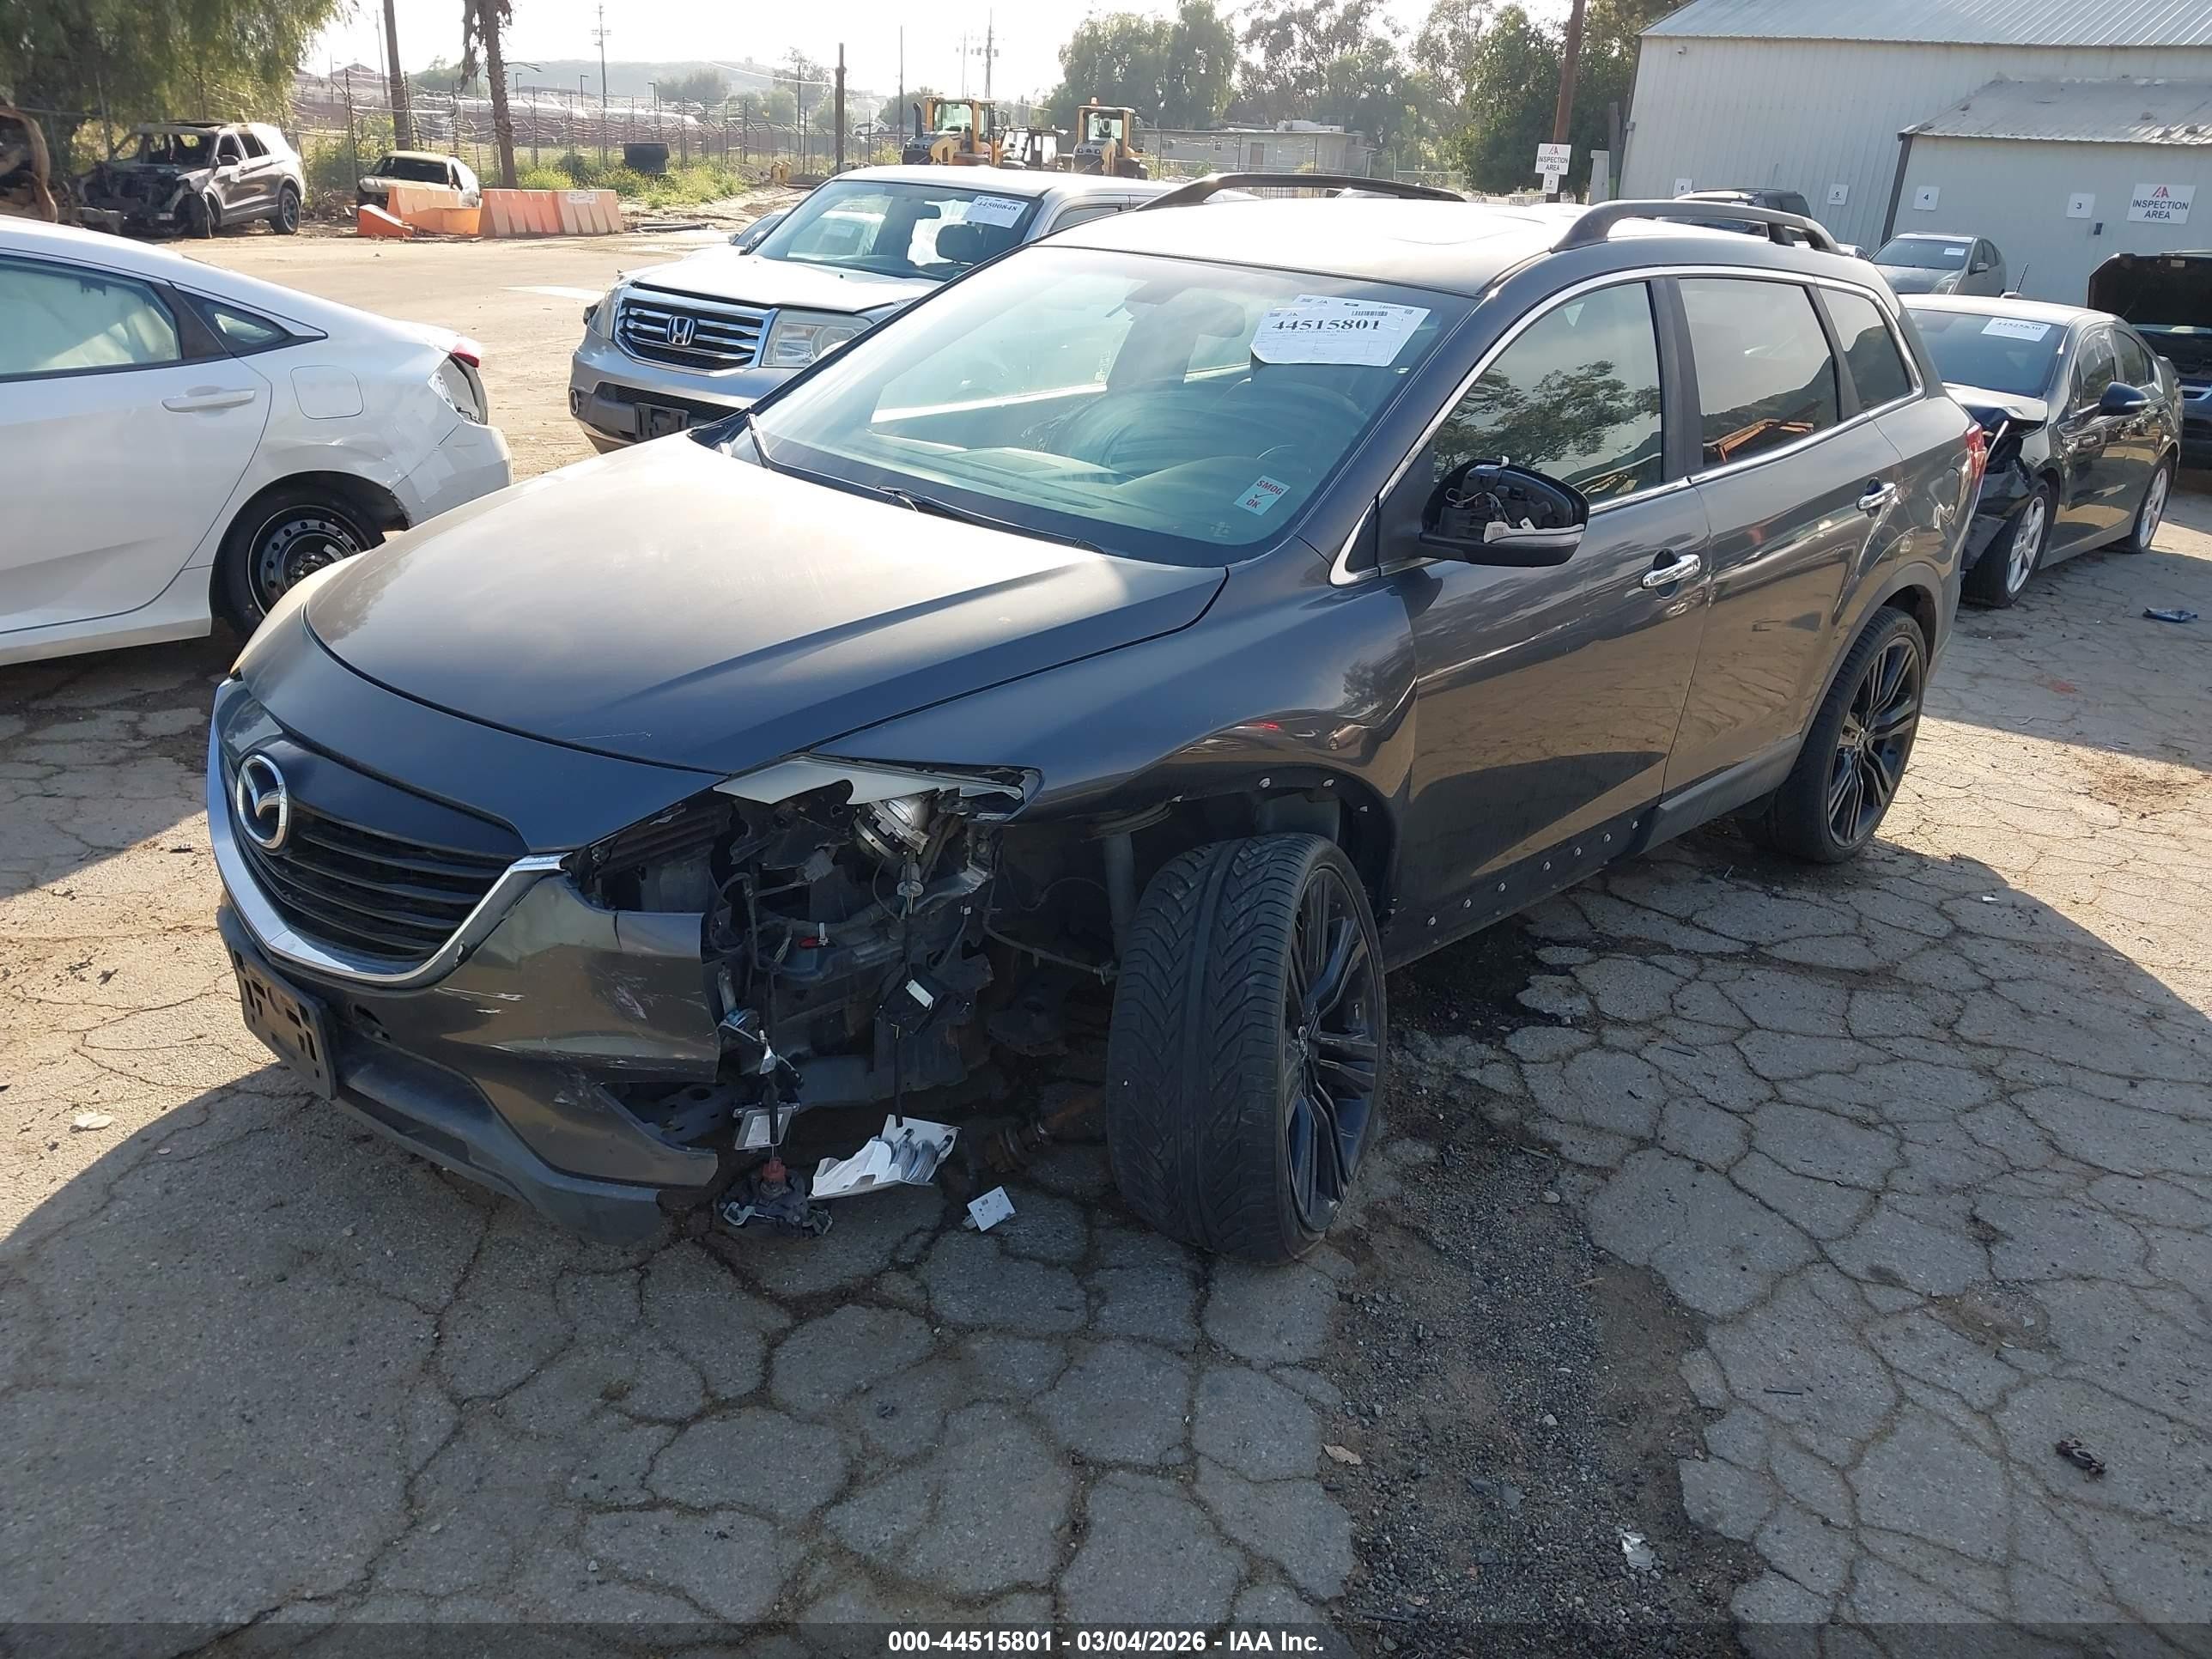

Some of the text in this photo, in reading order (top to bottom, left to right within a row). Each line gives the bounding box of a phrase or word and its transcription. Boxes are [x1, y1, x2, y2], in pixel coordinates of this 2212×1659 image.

[2132, 198, 2189, 210] INSPECTION
[2144, 210, 2170, 219] AREA
[1272, 319, 1380, 331] 44515801
[1256, 480, 1284, 495] SMOG
[1246, 499, 1261, 508] OK
